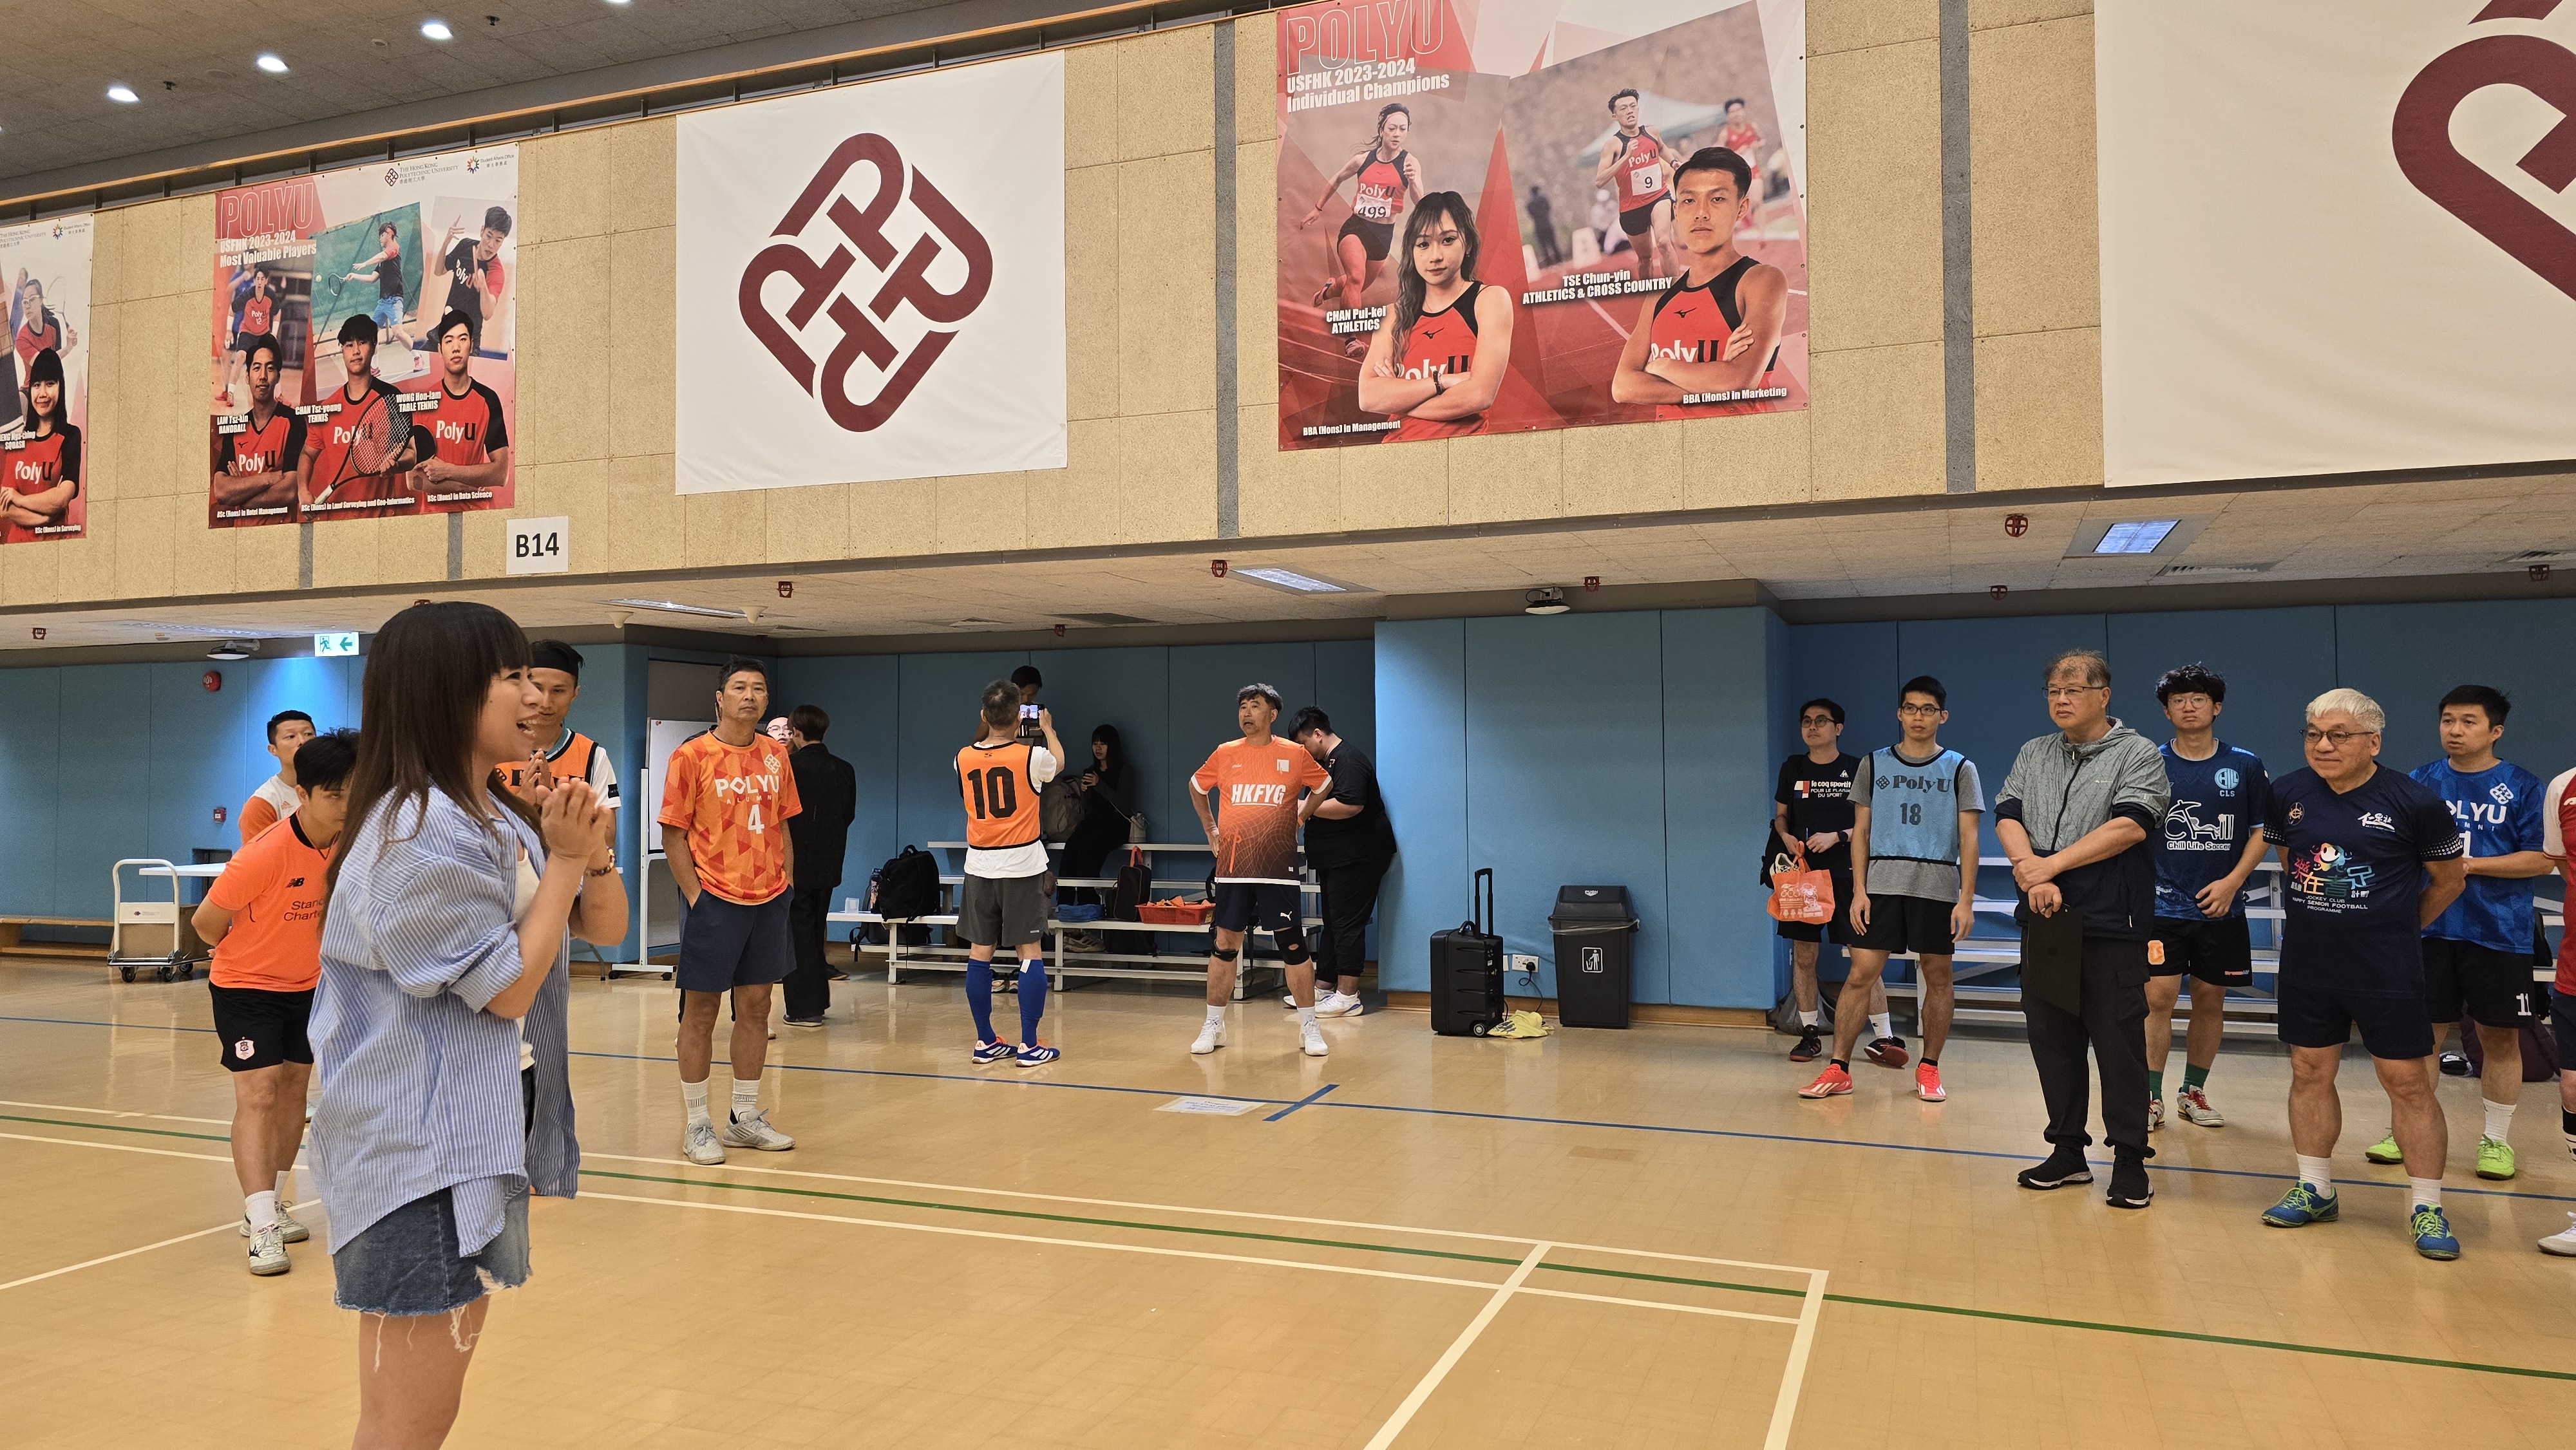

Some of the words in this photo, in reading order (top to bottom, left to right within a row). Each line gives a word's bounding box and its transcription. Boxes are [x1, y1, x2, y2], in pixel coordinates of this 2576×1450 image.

[1287, 0, 1444, 76] POLYU
[1287, 70, 1332, 94] USFHK
[1335, 57, 1416, 87] 2023-2024
[1287, 86, 1360, 113] Individual
[1363, 73, 1450, 101] Champions
[1628, 148, 1656, 168] PolyU
[1644, 176, 1653, 189] 9
[220, 182, 314, 240] POLYU
[1358, 205, 1387, 219] 499
[220, 238, 248, 253] USFHK
[249, 230, 296, 249] 2023-2024
[220, 253, 242, 268] Most
[243, 247, 282, 265] Valuable
[283, 243, 317, 259] Players
[1562, 274, 1581, 287] TSE
[1582, 269, 1631, 285] Chun-yin
[1522, 287, 1576, 305] ATHLETICS
[1577, 288, 1586, 298] &
[1587, 282, 1622, 297] CROSS
[1624, 276, 1673, 294] COUNTRY
[1325, 308, 1352, 323] CHAN
[1353, 305, 1387, 321] Pui-kei
[1331, 318, 1380, 335] ATHLETICS
[396, 392, 415, 403] WONG
[1683, 394, 1701, 404] BBA
[1701, 391, 1730, 403] (Hons)
[1731, 390, 1740, 400] in
[1741, 387, 1787, 400] Marketing
[295, 406, 311, 415] CHAN
[399, 402, 417, 413] TABLE
[417, 400, 439, 411] TENNIS
[216, 415, 229, 426] LAM
[307, 413, 328, 424] TENNIS
[218, 423, 247, 435] HANDBALL
[332, 422, 374, 446] PolyU
[435, 420, 477, 444] PolyU
[1303, 427, 1318, 437] BBA
[1318, 425, 1342, 435] (Hons)
[1343, 424, 1350, 433] in
[1352, 420, 1401, 433] Management
[5, 440, 26, 450] SQUASH
[238, 450, 276, 474] PolyU
[15, 460, 54, 484] PolyU
[471, 491, 493, 500] Science
[516, 531, 560, 558] B14
[714, 775, 779, 798] POLYU
[967, 766, 1018, 820] 10
[1892, 775, 1952, 794] PolyU
[726, 795, 772, 805] ALUMN
[1231, 784, 1287, 805] HKFYG
[748, 804, 765, 834] 4
[1900, 802, 1922, 825] 18
[2166, 841, 2186, 851] Chill
[2186, 841, 2205, 851] Life
[2307, 905, 2342, 914] PROGRAMME
[2515, 993, 2532, 1016] 11
